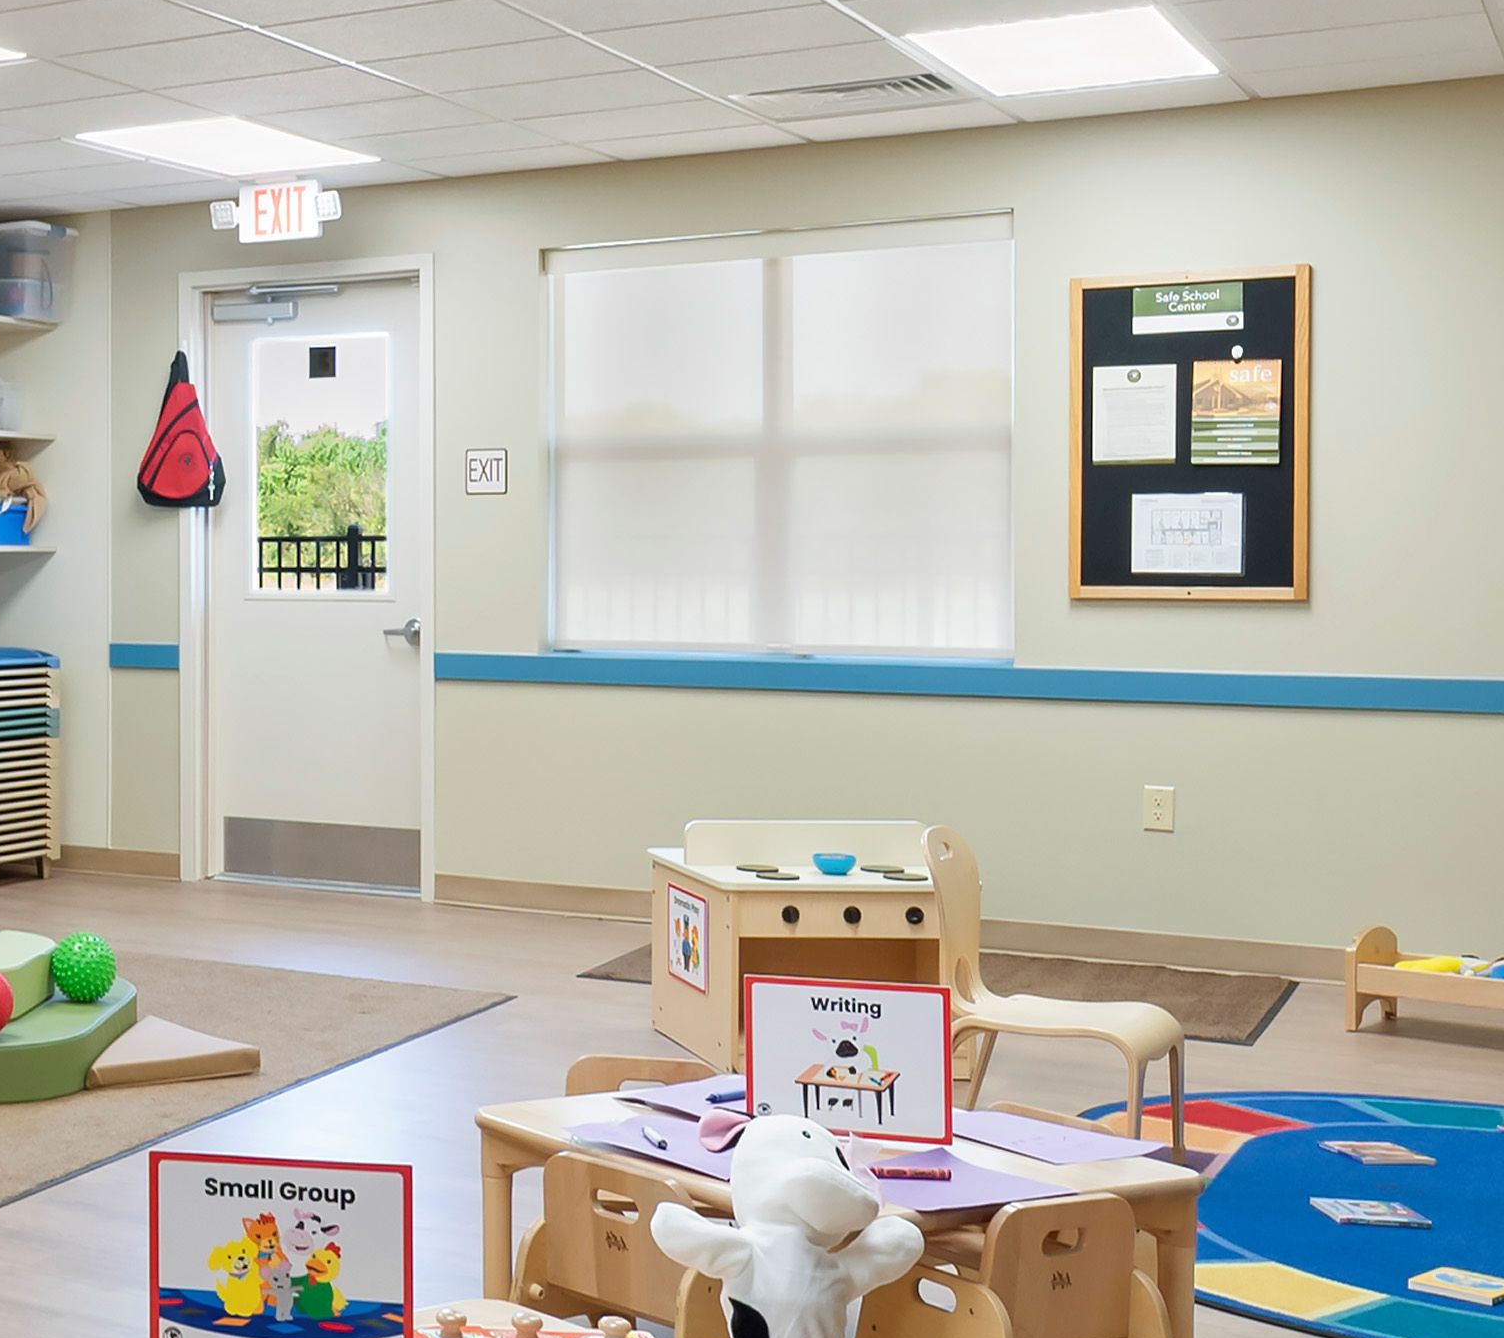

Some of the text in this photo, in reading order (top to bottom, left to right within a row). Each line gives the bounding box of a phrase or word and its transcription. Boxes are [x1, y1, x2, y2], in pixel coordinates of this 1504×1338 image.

[255, 186, 306, 235] EXIT
[1155, 288, 1221, 303] Safe School
[1168, 301, 1207, 312] Center
[1229, 364, 1273, 382] safe
[469, 457, 503, 482] EXIT
[810, 996, 882, 1019] Writing
[204, 1177, 356, 1210] Small Group
